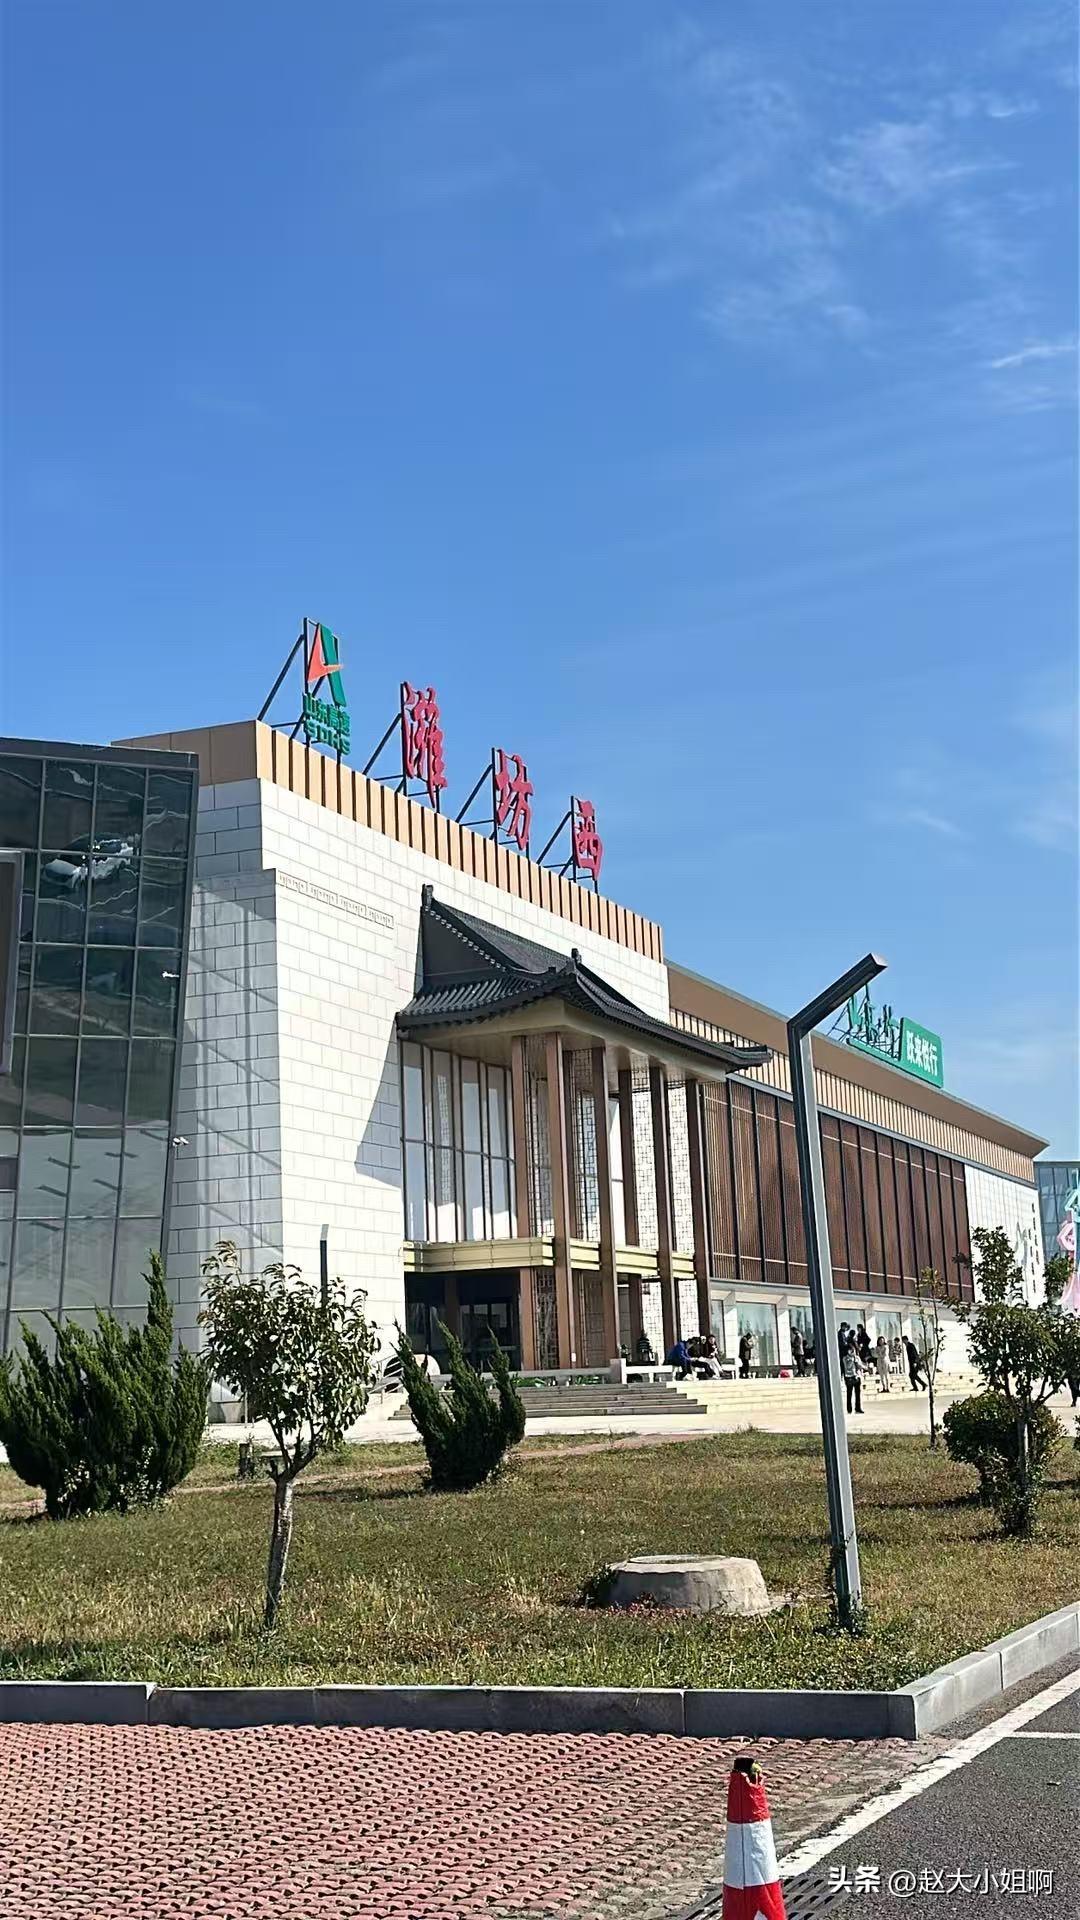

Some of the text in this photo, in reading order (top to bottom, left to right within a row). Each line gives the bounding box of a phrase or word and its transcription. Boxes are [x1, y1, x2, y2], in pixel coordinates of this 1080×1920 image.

[303, 693, 351, 736] 山东高速
[304, 719, 351, 755] SDHS
[404, 682, 603, 881] 潍坊西
